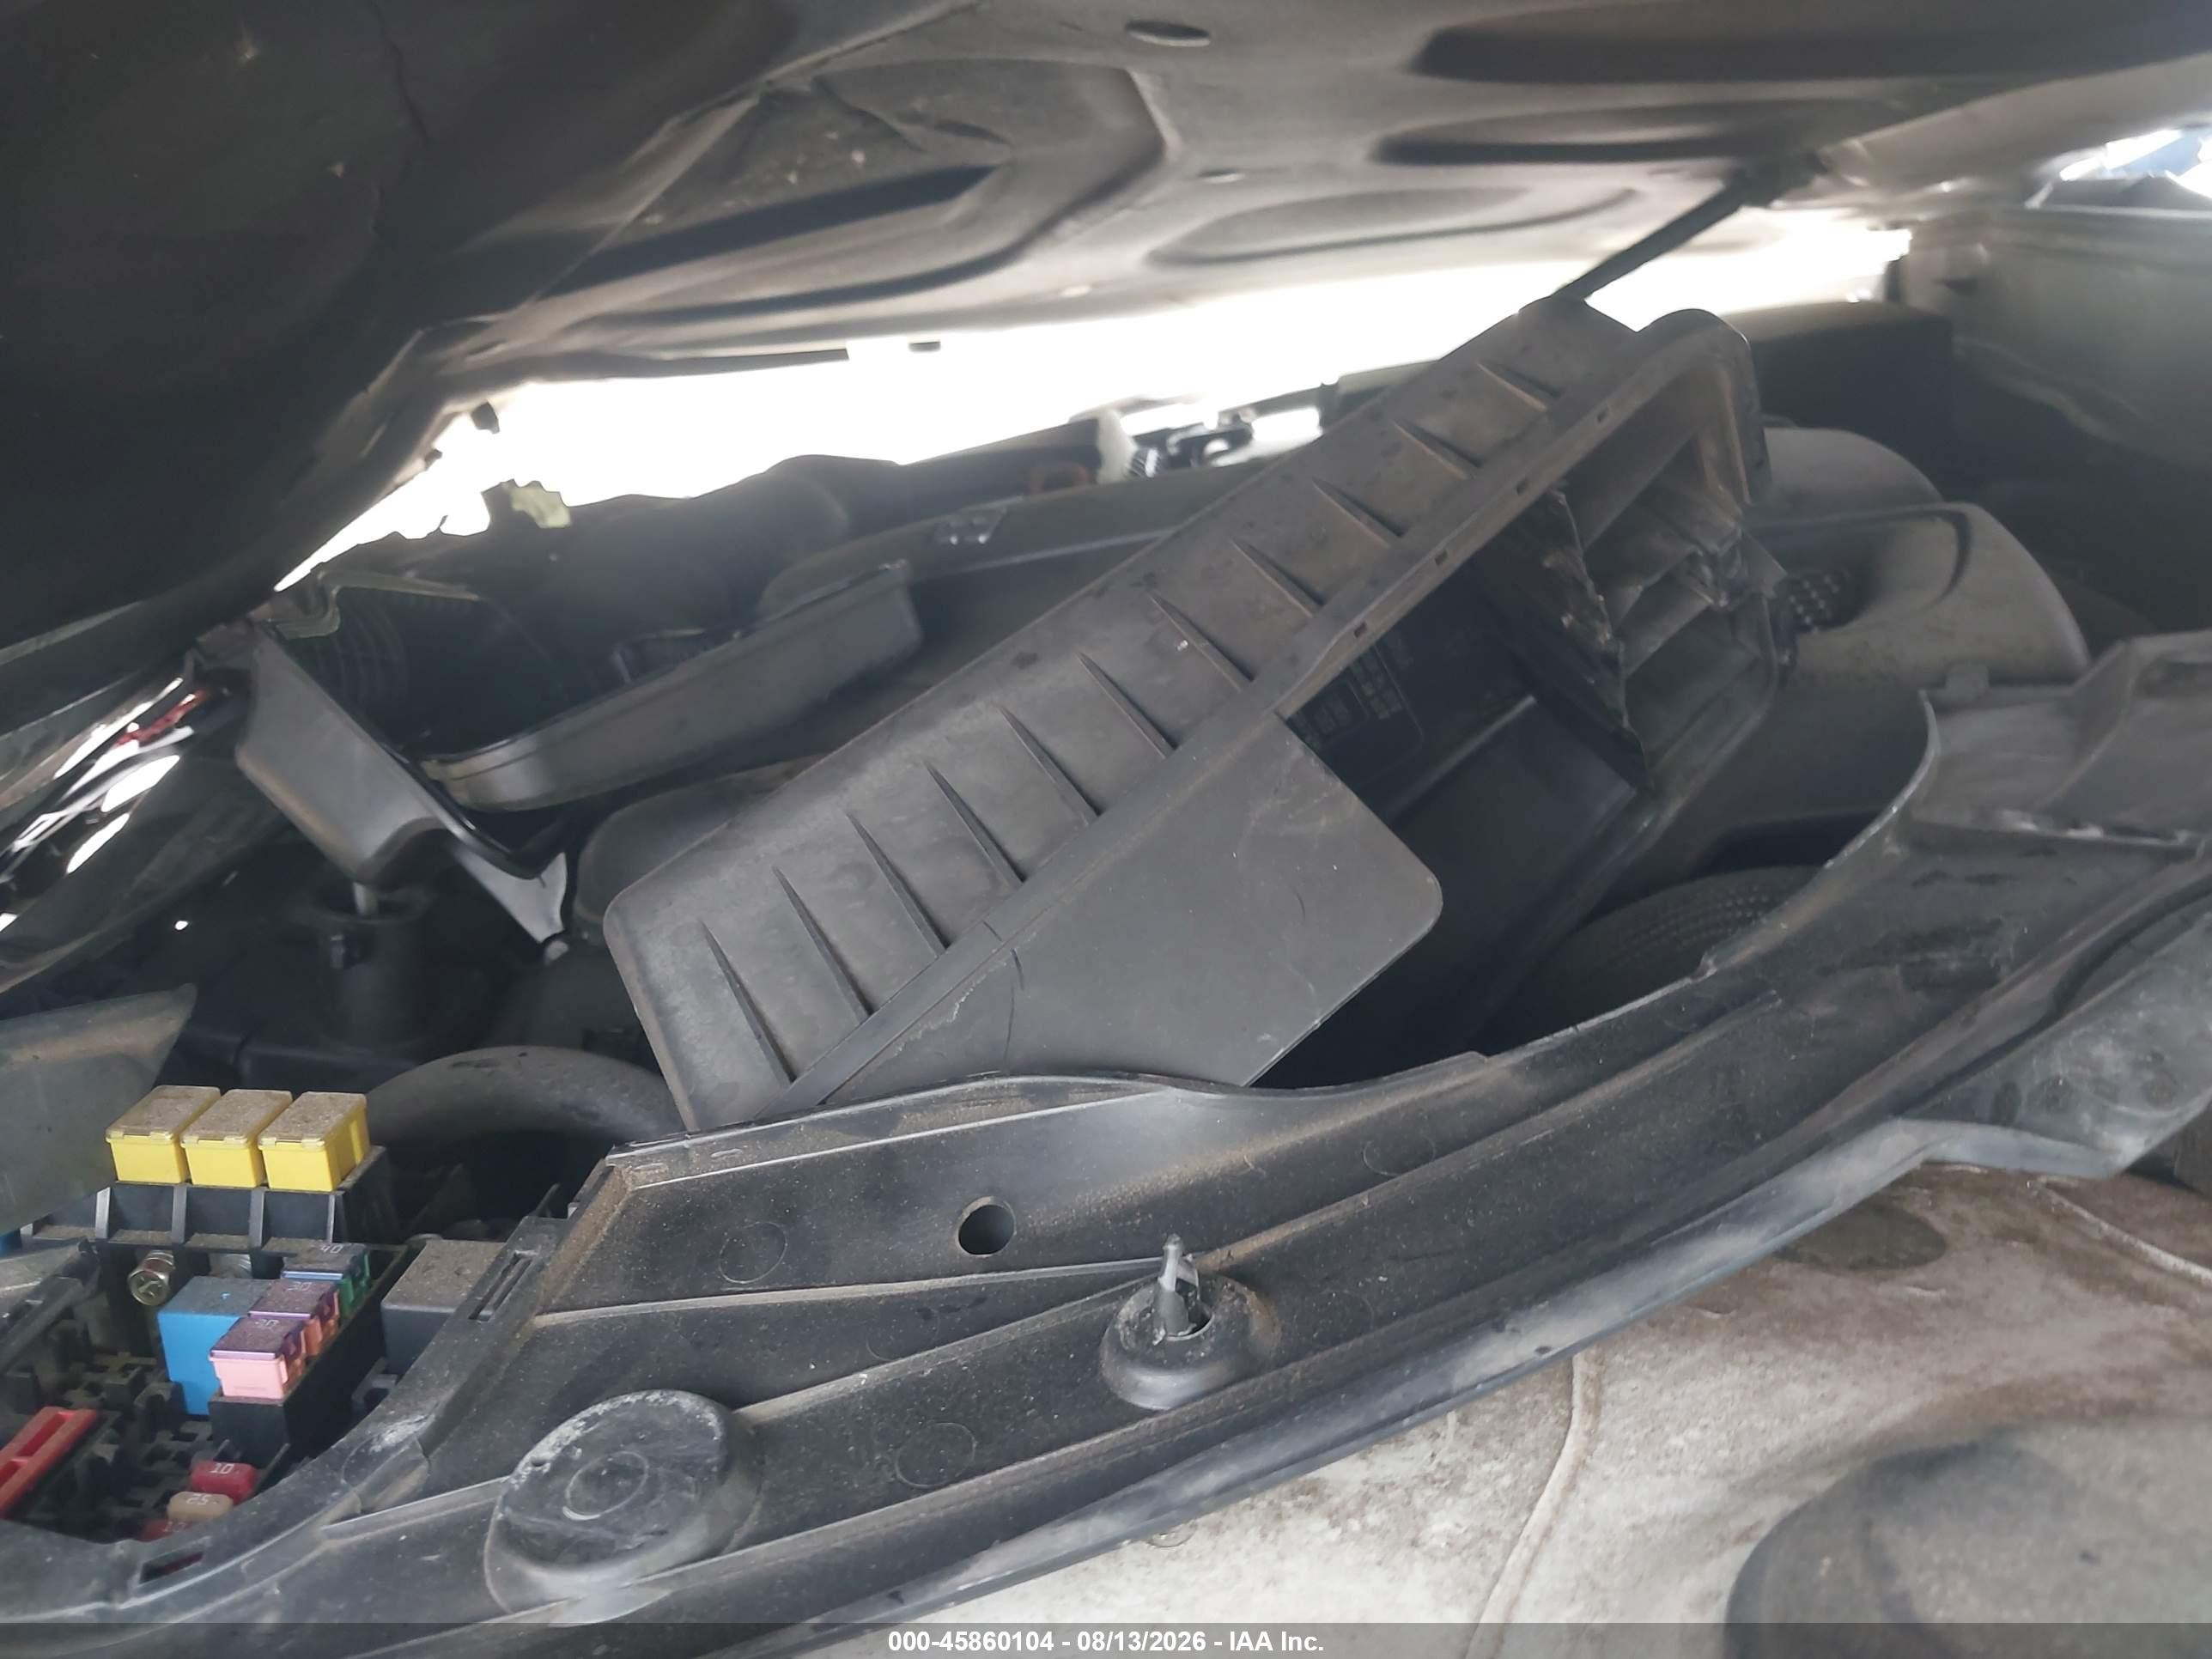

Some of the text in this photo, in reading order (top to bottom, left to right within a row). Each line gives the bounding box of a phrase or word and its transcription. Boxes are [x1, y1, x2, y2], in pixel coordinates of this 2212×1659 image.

[321, 1244, 343, 1255] 40
[210, 1462, 235, 1474] 10
[185, 1492, 212, 1505] 25
